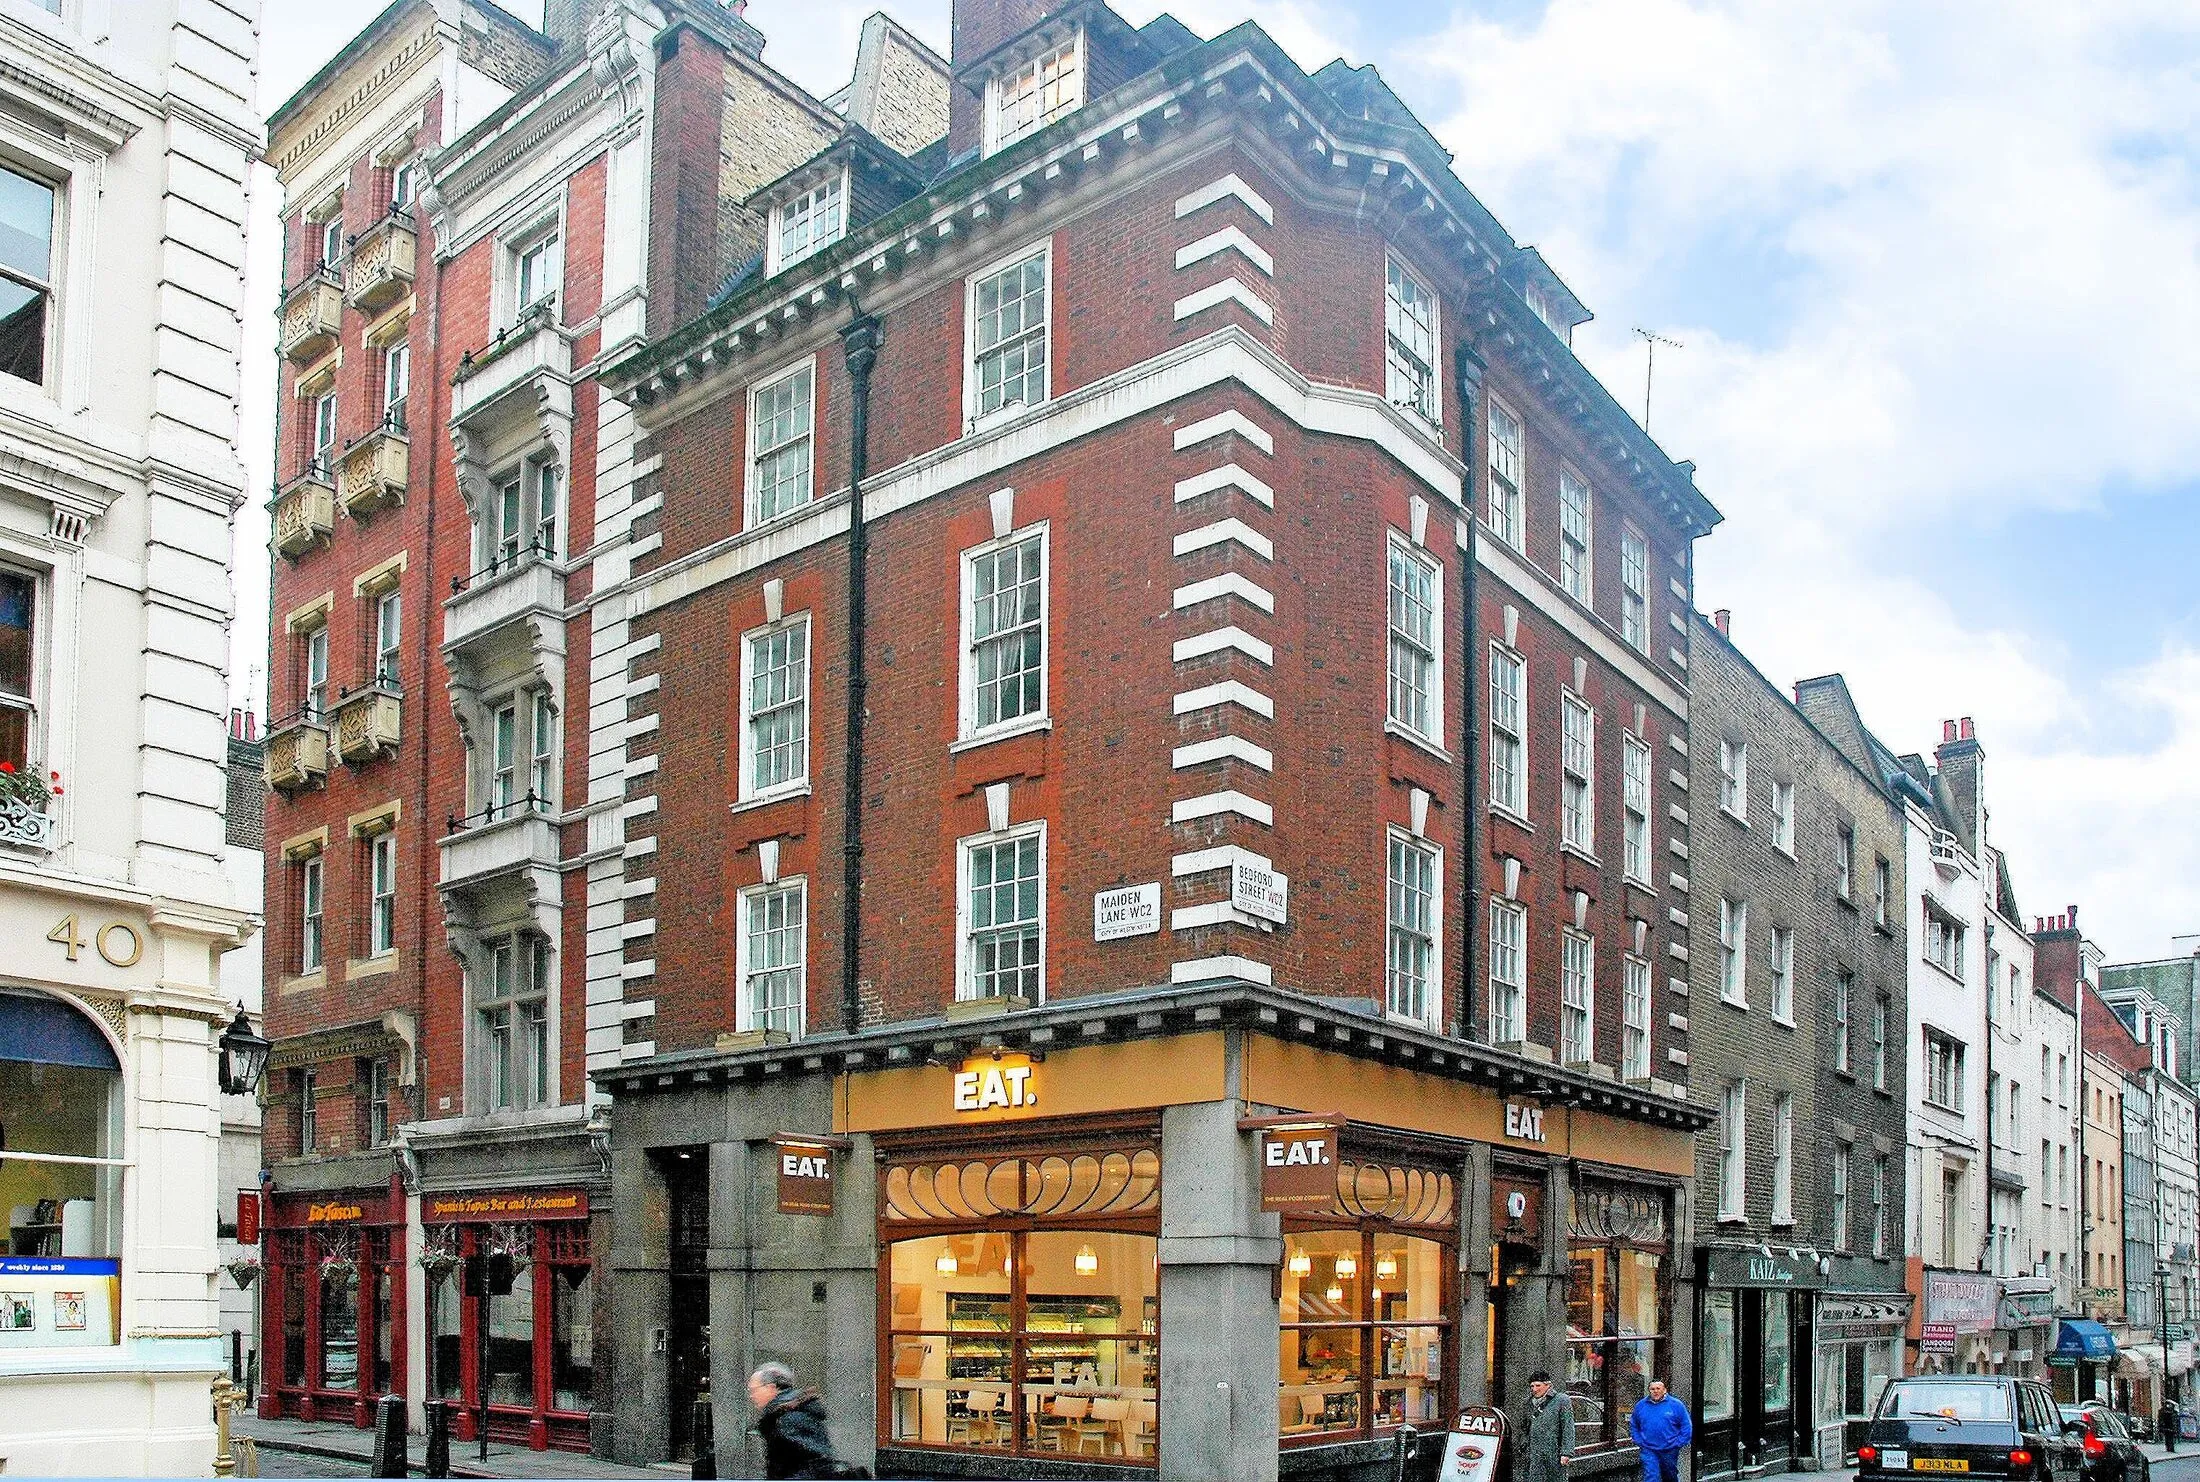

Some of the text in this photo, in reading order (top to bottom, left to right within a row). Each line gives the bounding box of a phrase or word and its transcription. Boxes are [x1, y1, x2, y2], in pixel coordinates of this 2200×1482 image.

[1239, 865, 1273, 888] BEDFORD
[1101, 891, 1141, 910] MAIDEN
[1239, 881, 1283, 907] STREET WC2
[1101, 904, 1152, 924] LANE WC2
[46, 912, 144, 968] 40
[954, 1066, 1038, 1112] EAT.
[1505, 1103, 1546, 1143] EAT.
[1265, 1140, 1330, 1168] EAT.
[783, 1155, 830, 1180] EAT.
[6, 1263, 31, 1272] weekly
[1923, 1325, 1955, 1333] STRAND
[1459, 1415, 1497, 1433] EAT.
